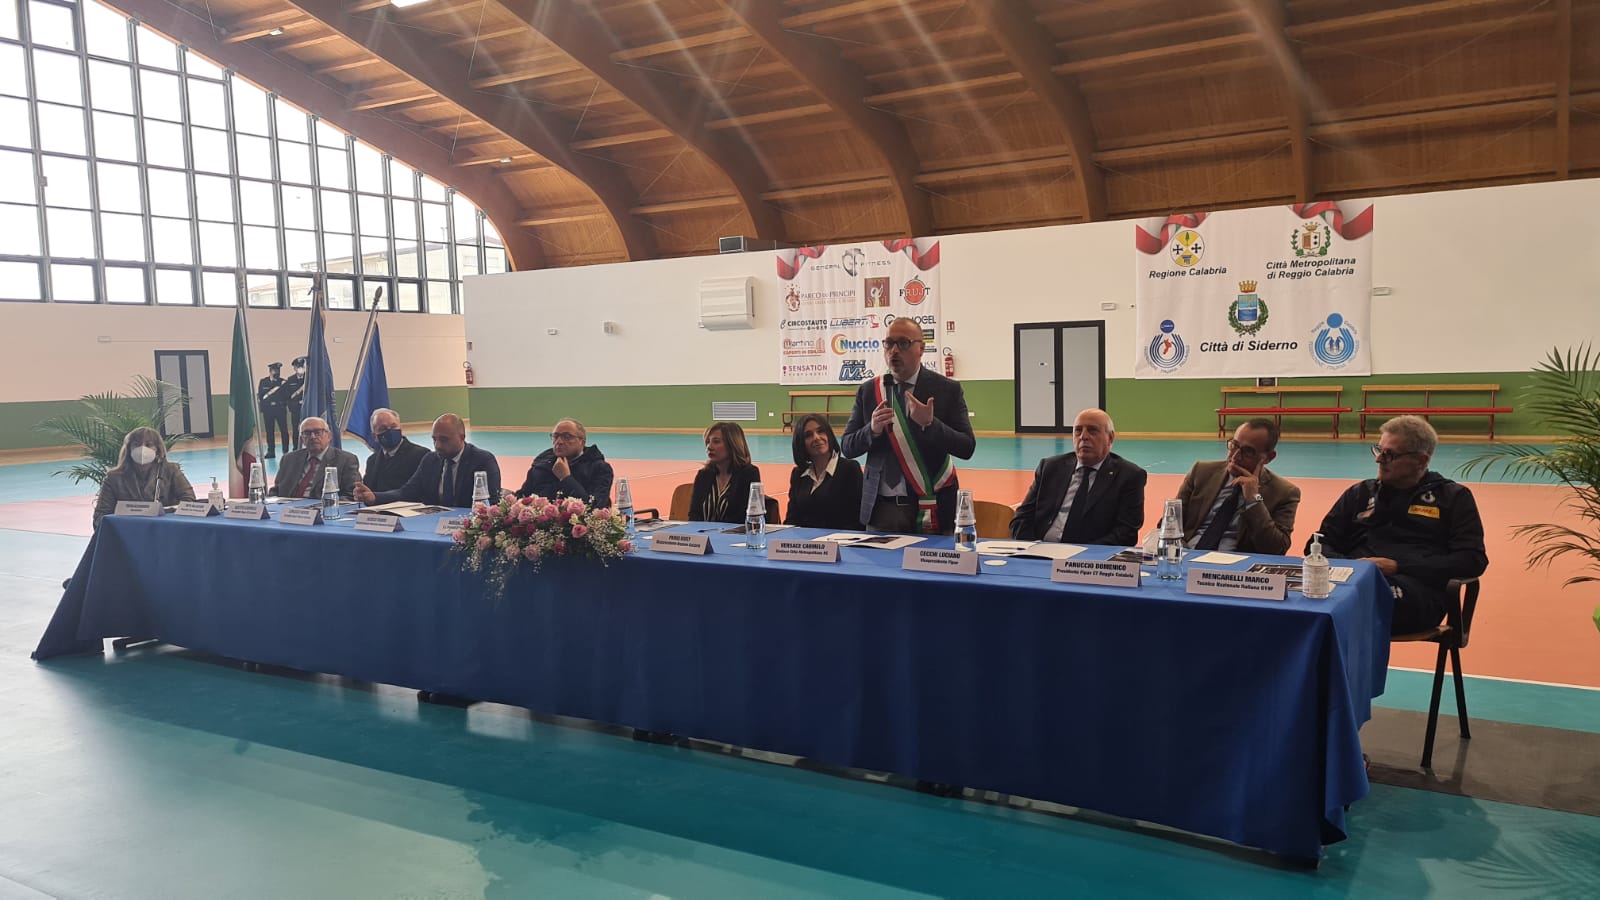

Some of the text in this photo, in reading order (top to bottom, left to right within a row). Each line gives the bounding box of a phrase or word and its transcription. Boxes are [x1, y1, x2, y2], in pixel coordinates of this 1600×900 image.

[1266, 257, 1356, 270] Città Metropolitana
[1149, 266, 1227, 280] Regione Calabria
[1267, 267, 1354, 280] di Reggio Calabria
[840, 339, 879, 349] Nuccio
[1200, 340, 1298, 352] Città di Siderno
[1065, 561, 1126, 571] PANUCCIO DOMENICO
[1202, 572, 1269, 584] MENCARELLI MARCO
